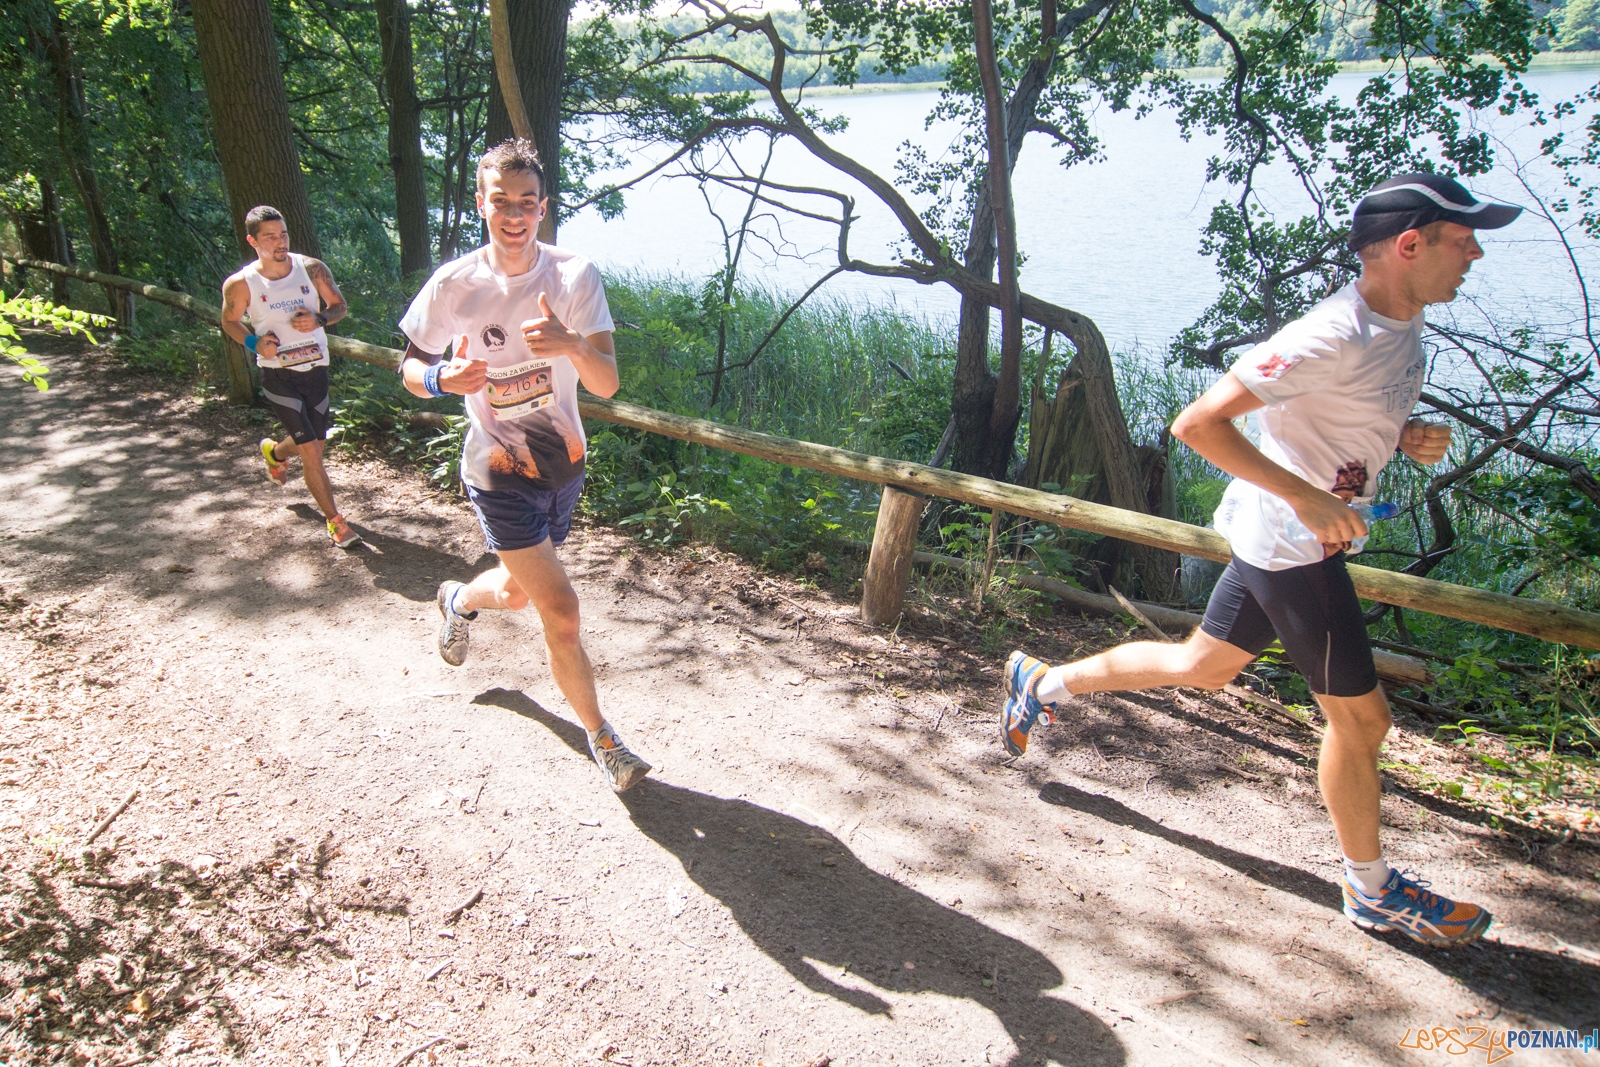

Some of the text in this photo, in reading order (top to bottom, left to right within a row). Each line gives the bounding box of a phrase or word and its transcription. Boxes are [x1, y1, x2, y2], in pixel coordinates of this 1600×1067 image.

[269, 298, 304, 310] KOŚCIAN
[509, 368, 519, 376] ZA
[519, 361, 547, 373] WILKIEM
[502, 376, 531, 397] 216
